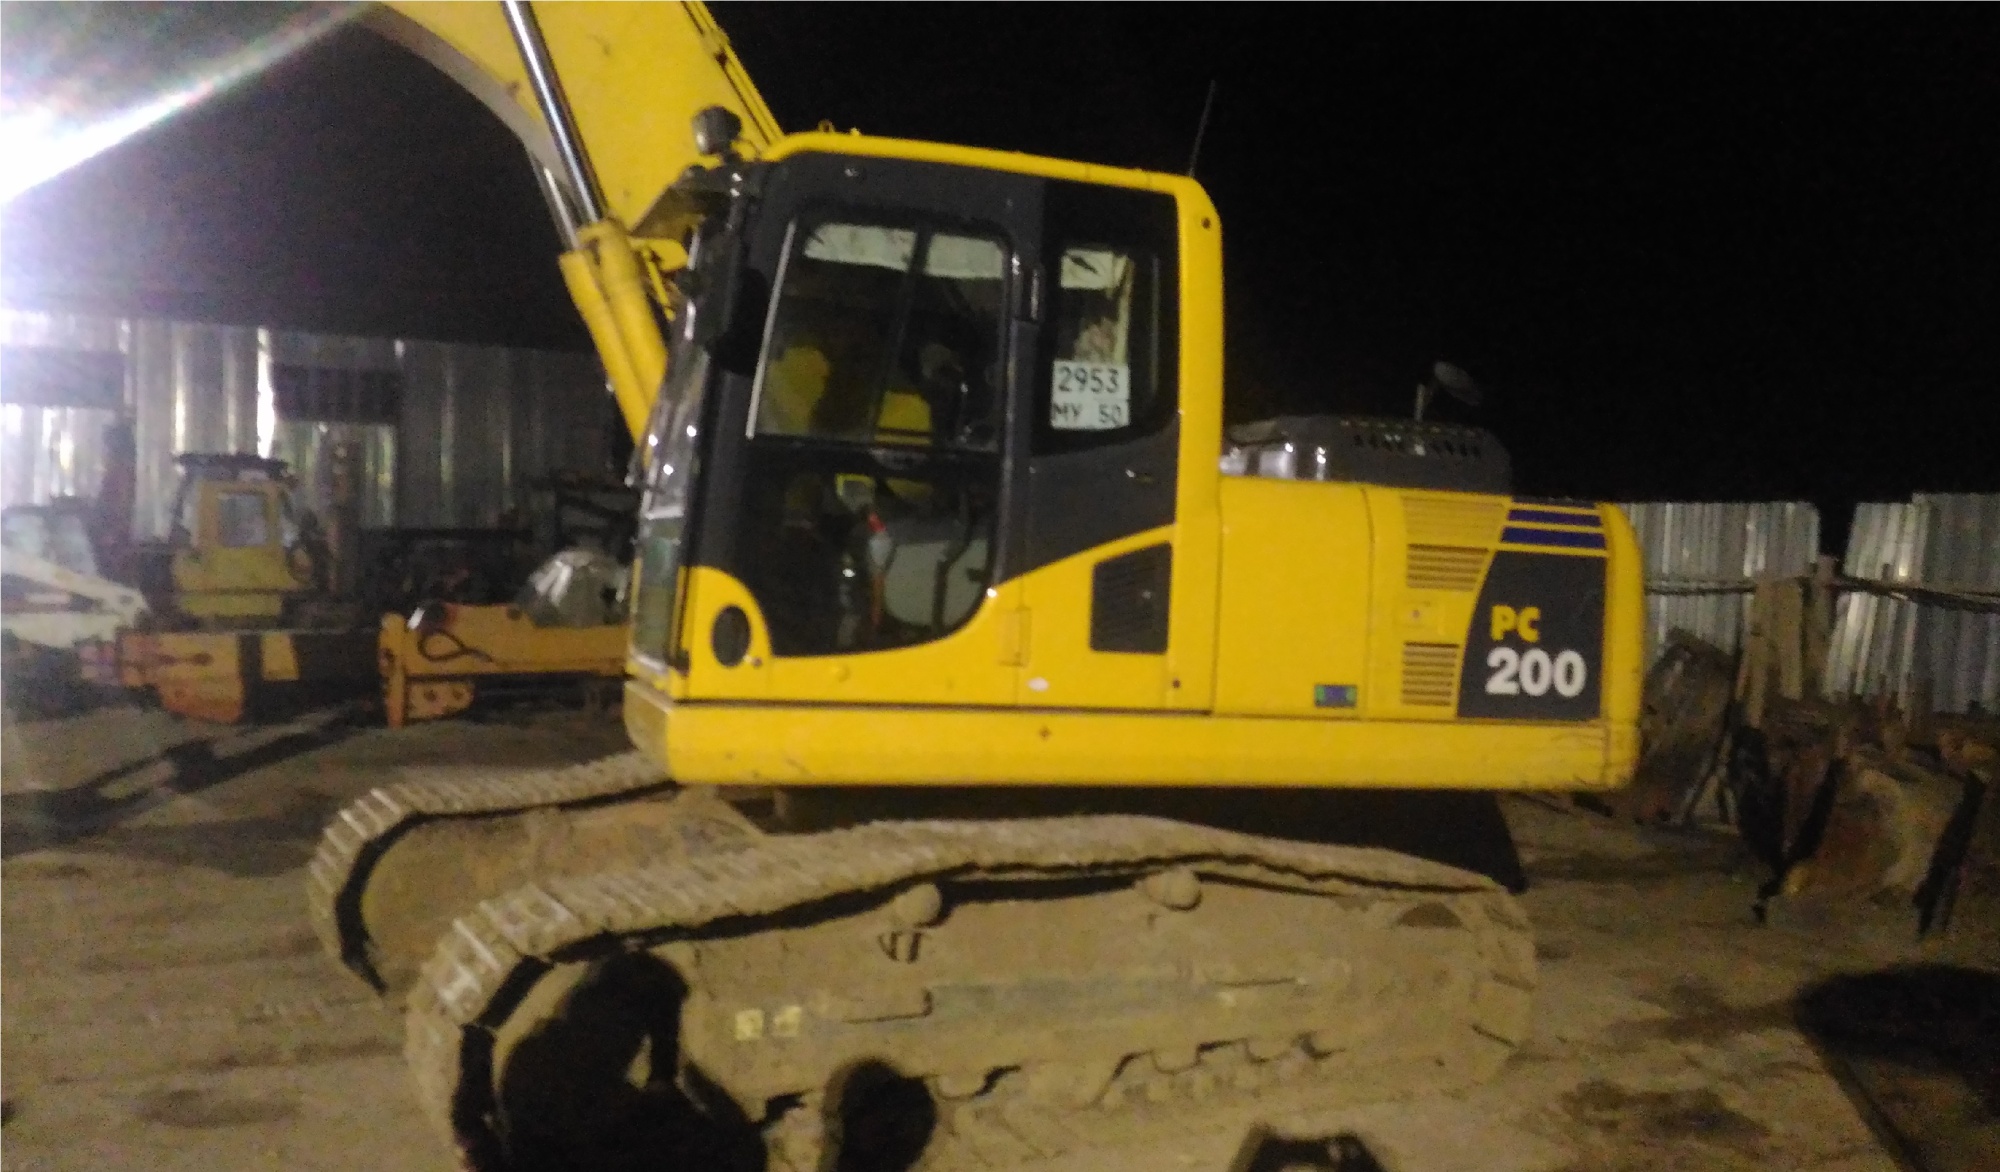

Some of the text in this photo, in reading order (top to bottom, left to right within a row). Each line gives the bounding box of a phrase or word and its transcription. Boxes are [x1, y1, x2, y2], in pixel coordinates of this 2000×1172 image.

[1058, 365, 1119, 394] 2953
[1490, 604, 1540, 643] PC
[1485, 646, 1586, 698] 200
